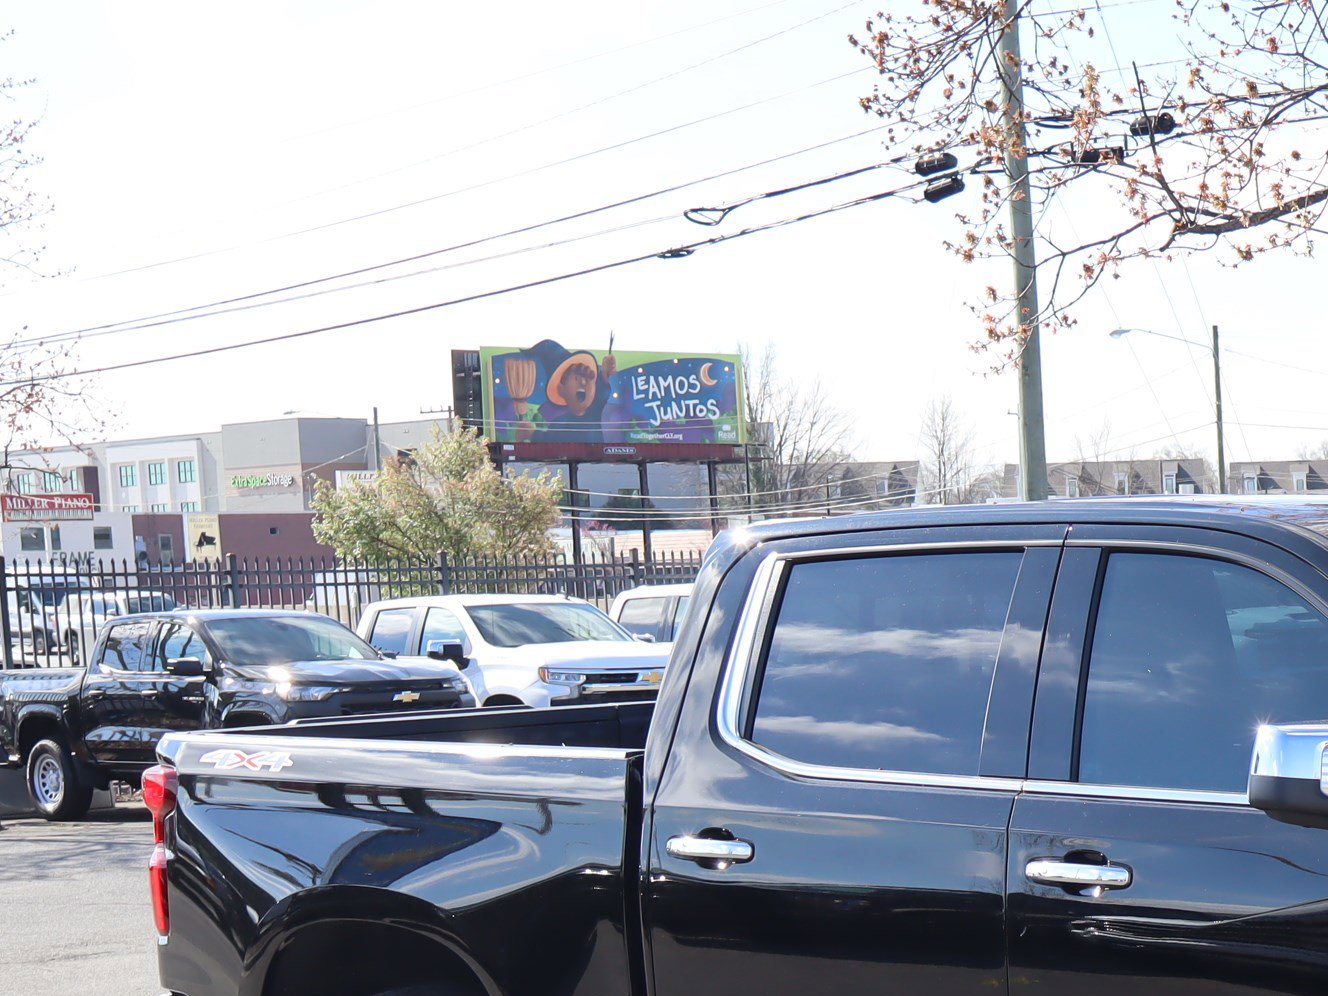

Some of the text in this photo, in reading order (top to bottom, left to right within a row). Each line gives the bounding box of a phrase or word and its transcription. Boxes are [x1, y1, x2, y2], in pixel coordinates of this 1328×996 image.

[631, 374, 701, 400] LEAMOS
[718, 431, 736, 439] Read
[266, 472, 293, 488] Storage
[5, 496, 90, 509] MILLER PIANO
